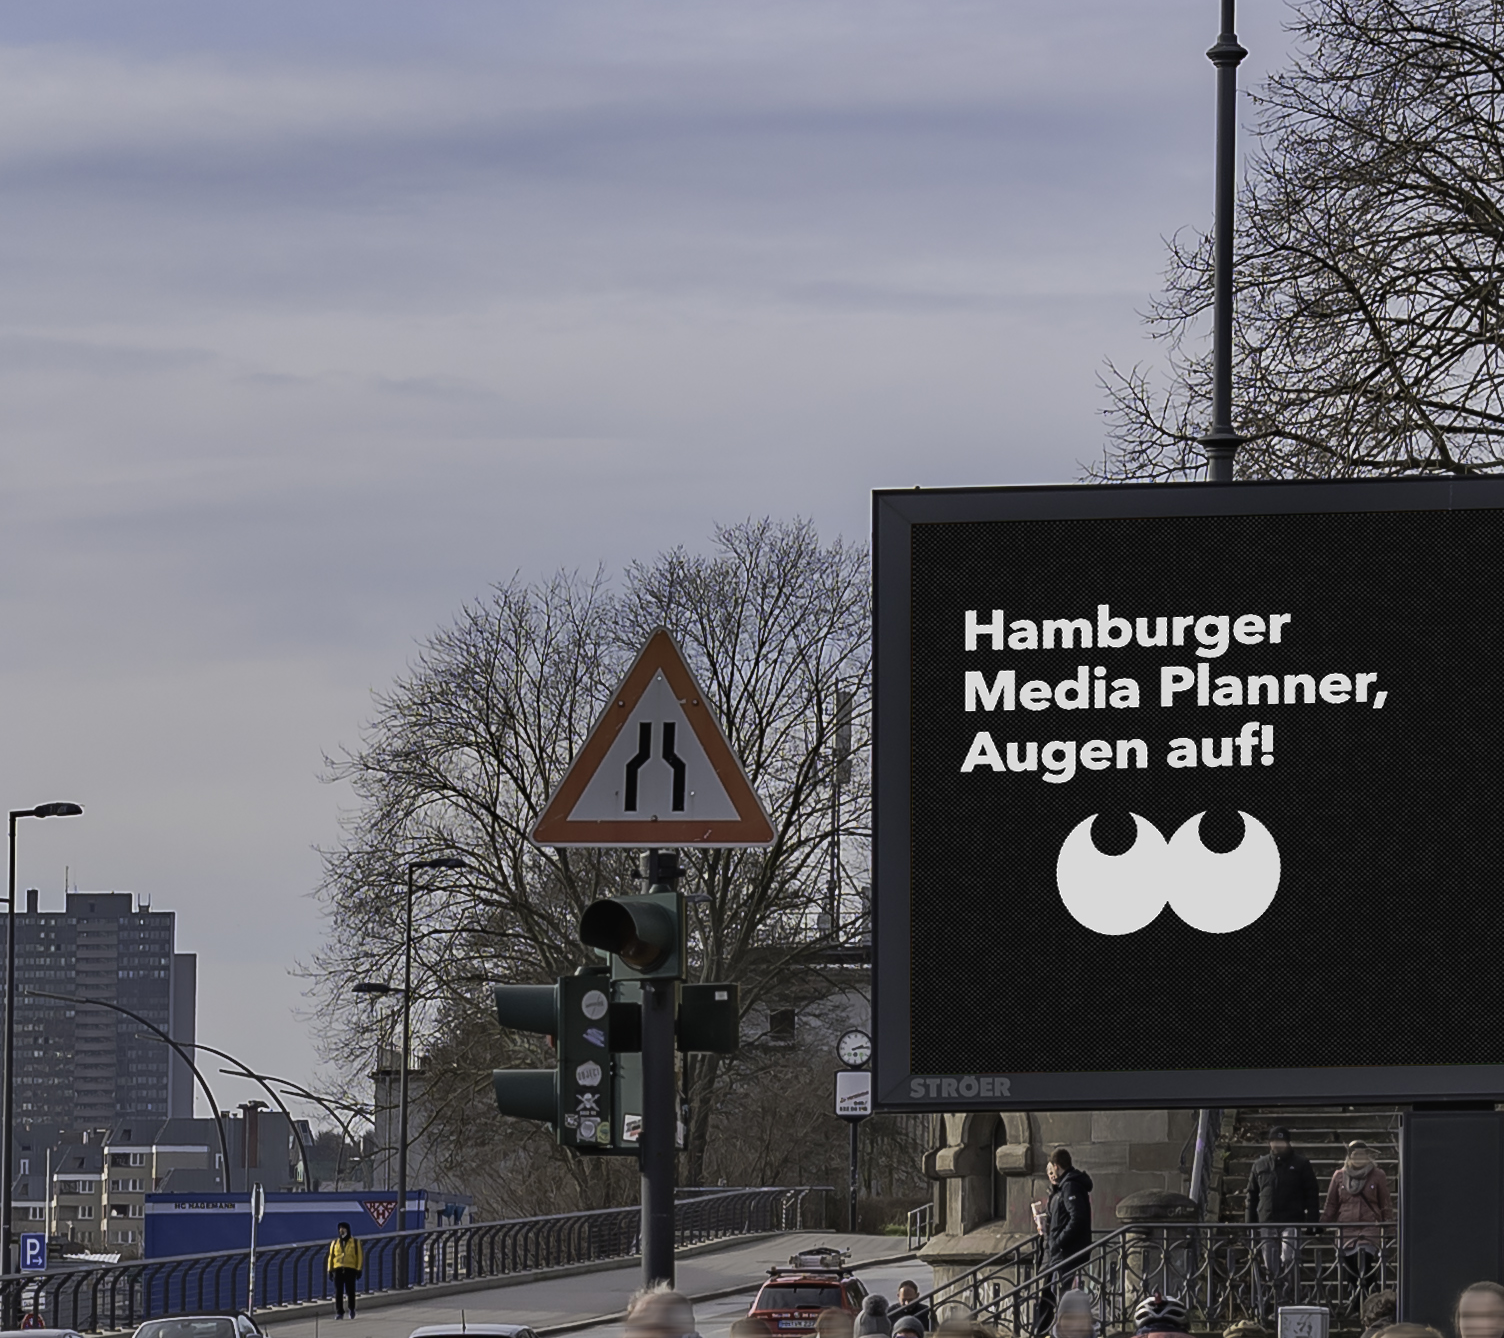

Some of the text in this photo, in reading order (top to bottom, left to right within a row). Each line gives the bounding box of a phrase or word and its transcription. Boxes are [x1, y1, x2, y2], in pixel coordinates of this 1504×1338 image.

[965, 604, 1291, 659] Hamburger
[965, 662, 1388, 712] Media Planner,
[960, 721, 1274, 784] Augen auf!
[910, 1075, 1011, 1099] STRÖER
[26, 1238, 40, 1265] P
